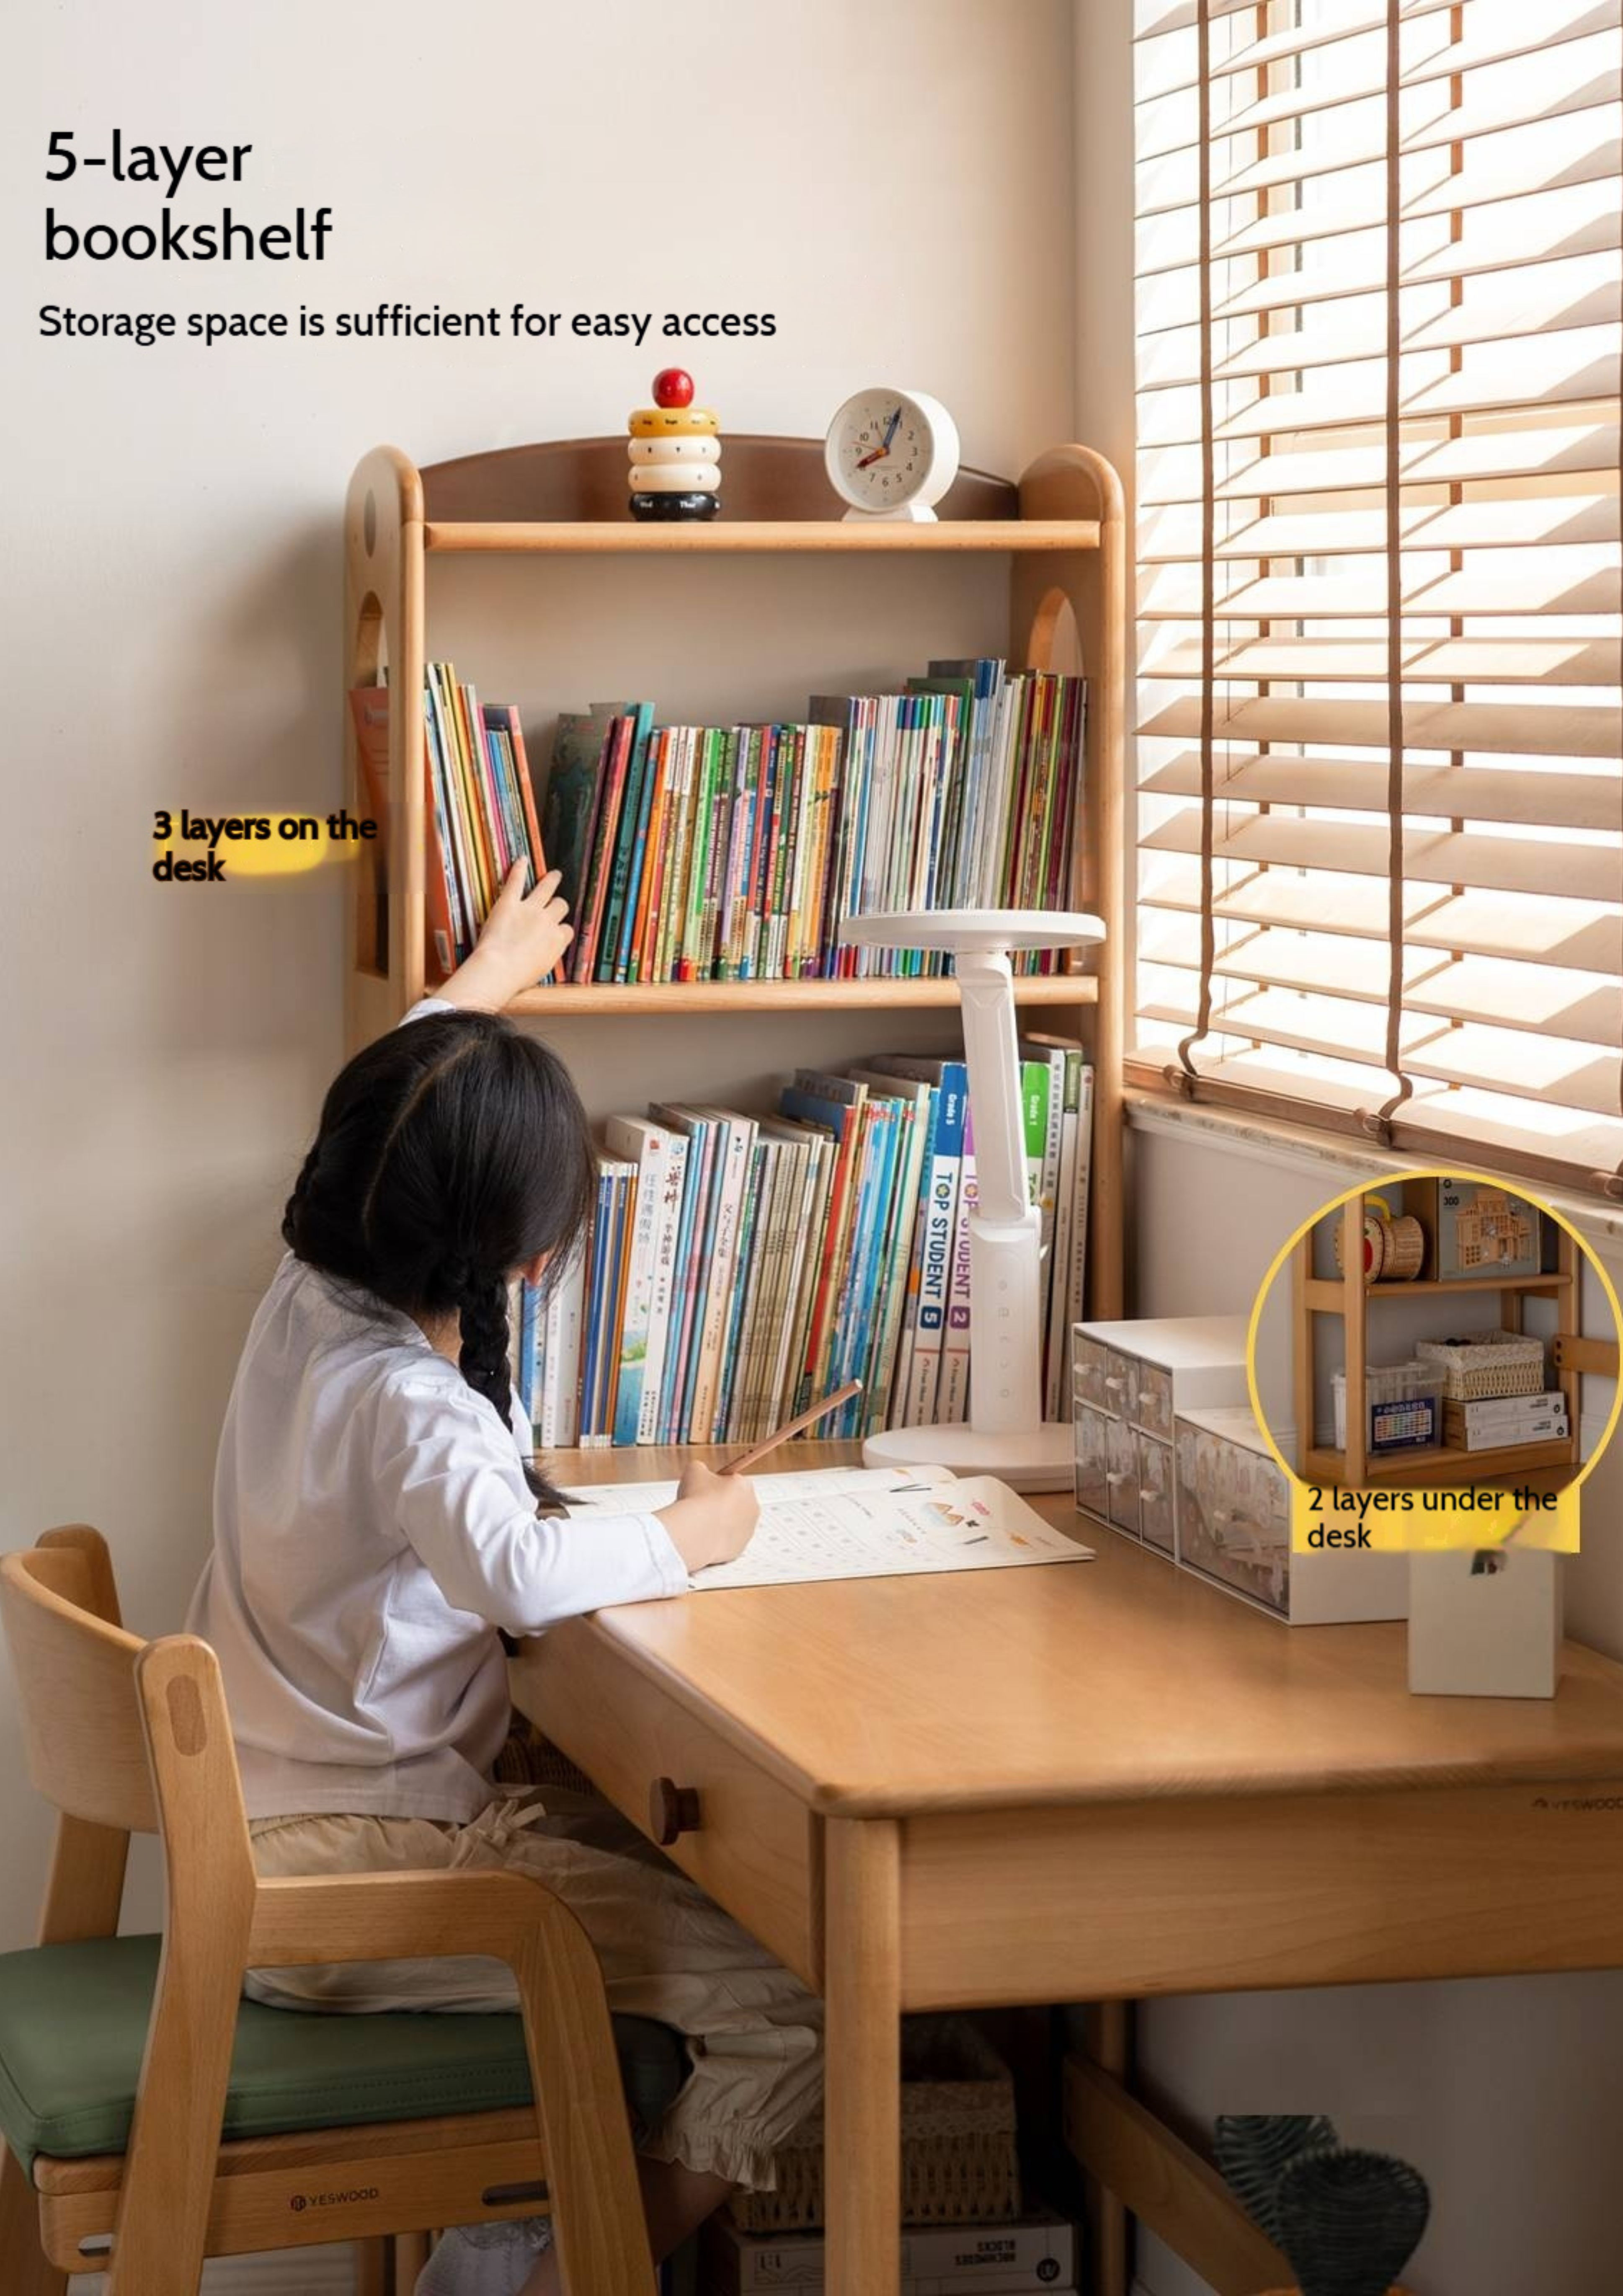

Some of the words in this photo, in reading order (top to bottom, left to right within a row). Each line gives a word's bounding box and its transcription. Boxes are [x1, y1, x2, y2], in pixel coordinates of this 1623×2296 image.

[933, 1172, 953, 1211] TOP
[924, 1217, 948, 1299] STUDENT
[309, 2187, 379, 2206] YESWOOD
